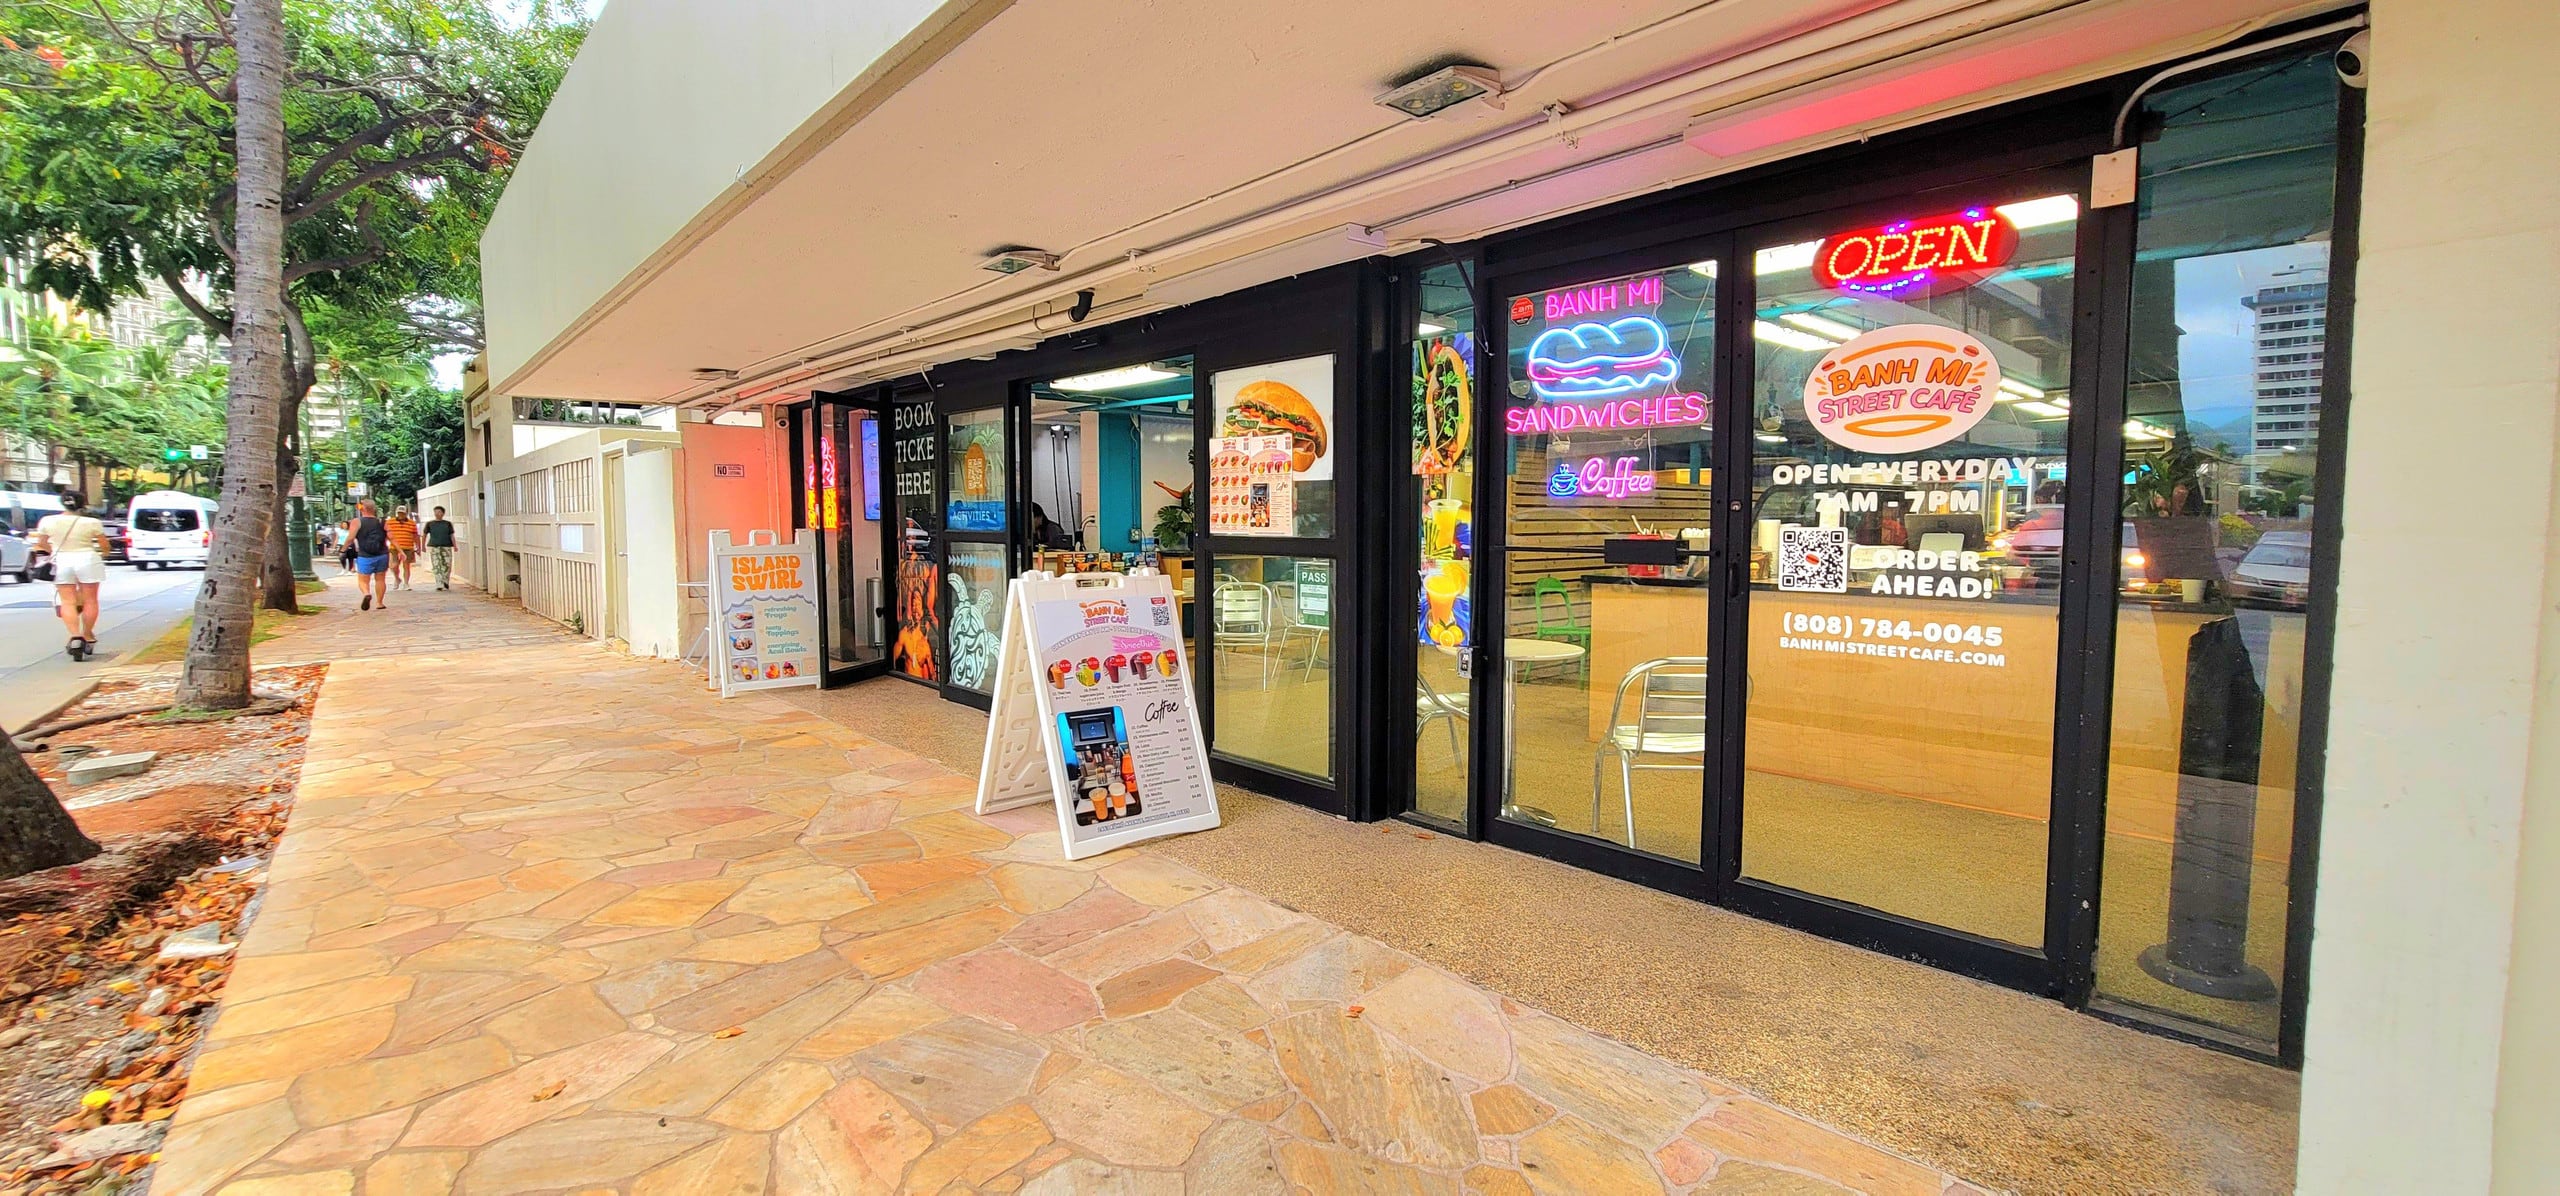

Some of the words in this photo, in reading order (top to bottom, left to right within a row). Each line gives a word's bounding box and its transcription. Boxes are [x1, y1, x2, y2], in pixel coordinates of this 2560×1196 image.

[1828, 219, 1997, 281] OPEN
[1545, 284, 1618, 319] BANH
[1627, 277, 1662, 307] MI
[1828, 358, 1919, 397] BANH
[1925, 357, 1973, 387] MI
[895, 401, 935, 431] BOOK
[1506, 394, 1706, 433] SANDWICHES
[1817, 388, 1907, 424] STREET
[1910, 385, 1983, 414] CAFÉ
[717, 465, 727, 476] NO
[1578, 456, 1654, 498] Coffee
[1772, 463, 1851, 486] OPEN
[1861, 456, 2037, 483] EVERYDAY
[896, 471, 932, 496] HERE
[1813, 491, 1878, 513] 7AM
[1904, 489, 1979, 513] 7PM
[952, 510, 990, 522] ACTIVITIES
[731, 555, 801, 575] ISLAND
[1872, 549, 1982, 572] ORDER
[731, 569, 803, 592] SWIRL
[1301, 571, 1327, 583] PASS
[1871, 574, 1993, 600] AHEAD!
[1084, 615, 1110, 628] STREET
[1085, 605, 1111, 619] BANH
[1113, 605, 1126, 616] MI
[1782, 611, 1854, 639] (808)
[1860, 617, 2003, 647] 784-0045
[1779, 636, 2006, 667] BANHMISTREETCAFE.COM
[1144, 699, 1179, 724] Coffee
